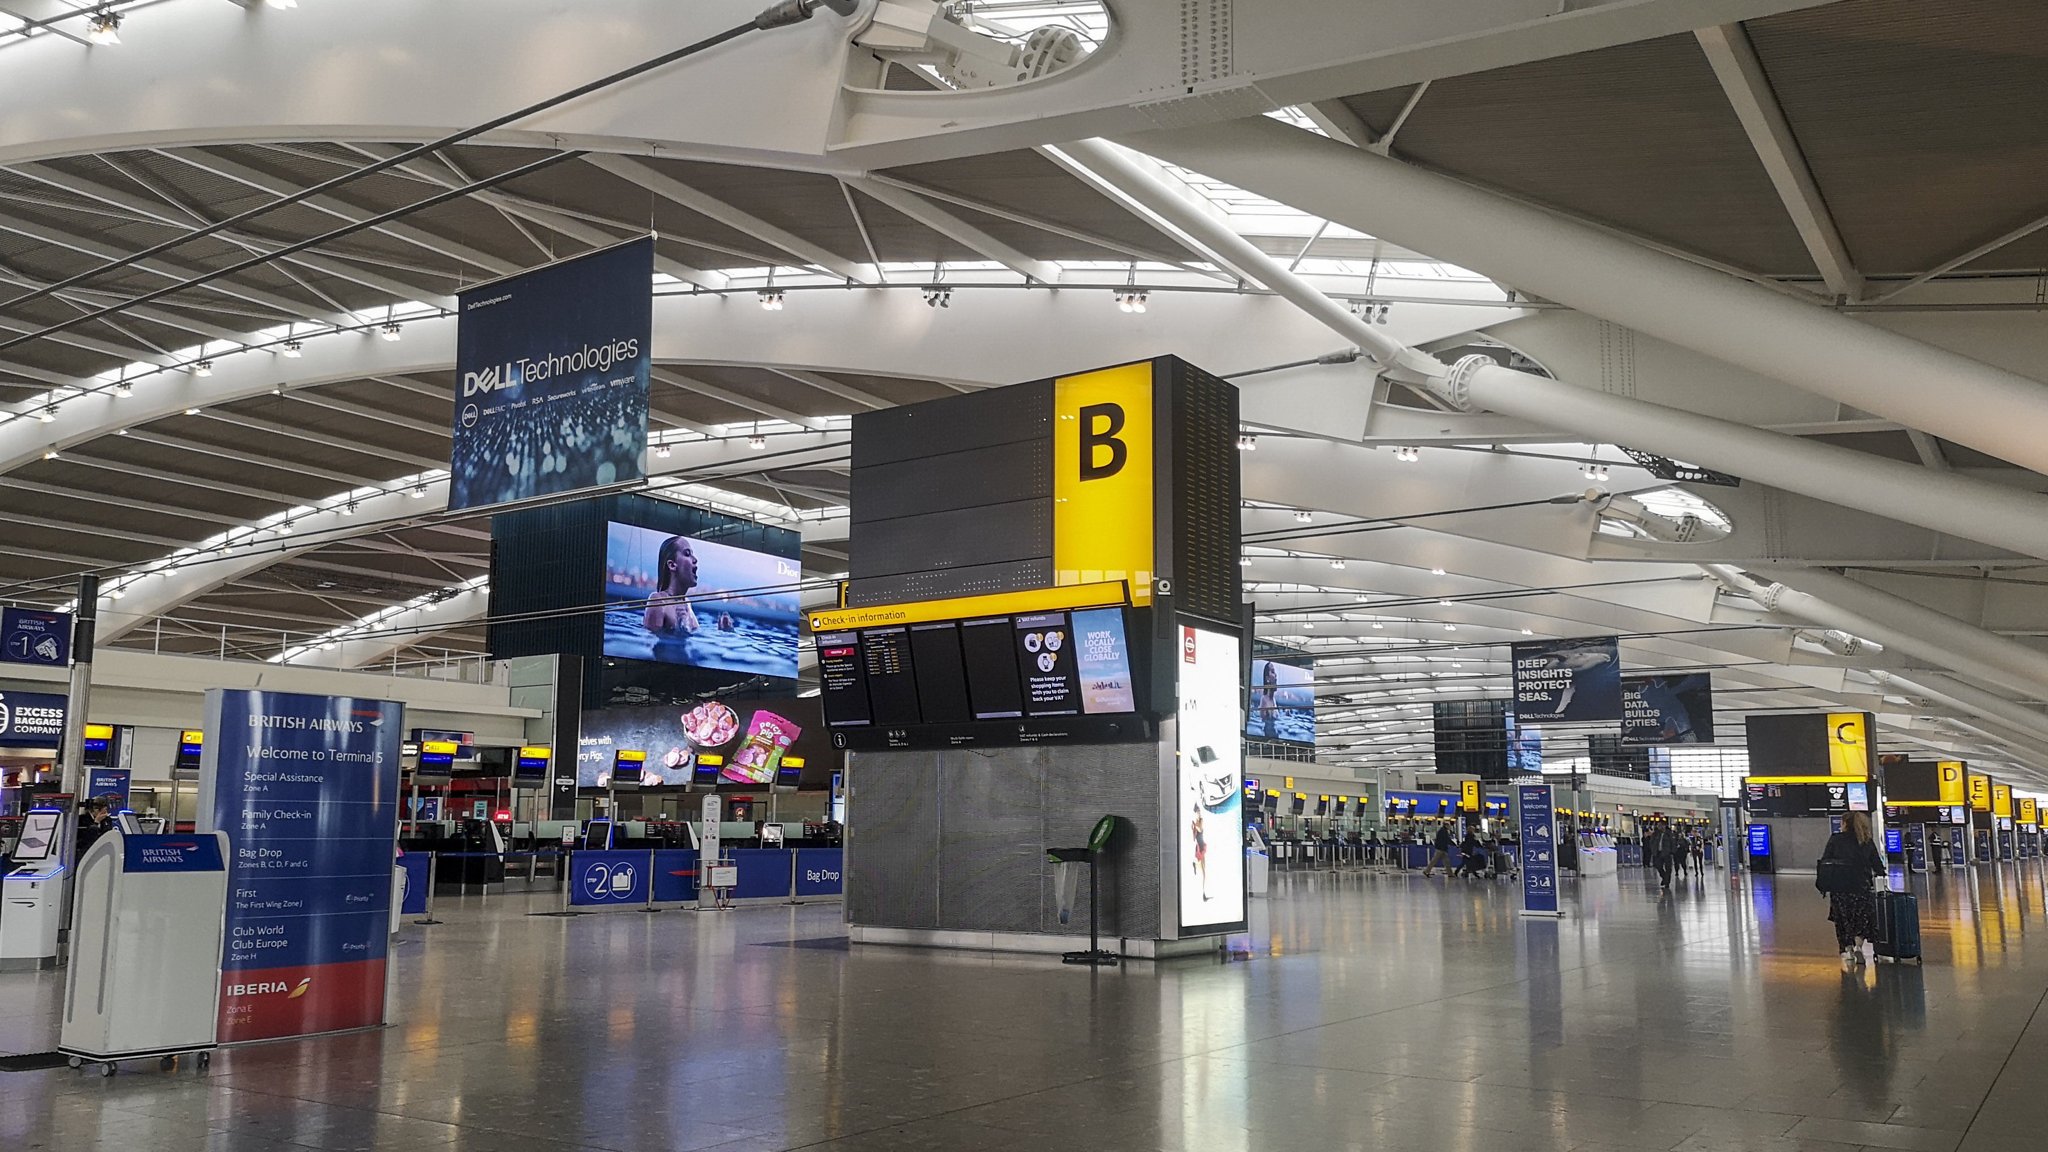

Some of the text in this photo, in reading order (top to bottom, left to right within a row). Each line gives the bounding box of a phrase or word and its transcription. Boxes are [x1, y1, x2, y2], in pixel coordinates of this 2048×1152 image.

[464, 338, 638, 398] DELL Technologies
[532, 396, 544, 404] RSA
[1080, 403, 1127, 482] B
[777, 561, 799, 578] Dior
[822, 611, 906, 626] Check-in information
[1088, 631, 1110, 639] WORK
[21, 636, 28, 655] 1
[1085, 638, 1115, 647] LOCALLY
[1090, 646, 1112, 654] CLOSE
[1084, 652, 1120, 661] GLOBALLY
[1517, 659, 1547, 668] DEEP
[1518, 669, 1573, 679] INSIGHTS
[1519, 680, 1572, 690] PROTECT
[1519, 692, 1552, 701] SEAS.
[16, 707, 63, 718] EXCESS
[14, 717, 62, 726] BAGGAGE
[249, 715, 364, 733] BRITISH AIRWAYS
[1626, 719, 1660, 727] CITIES.
[14, 725, 62, 734] COMPANY
[760, 722, 782, 735] percy
[1837, 723, 1856, 744] C
[761, 729, 774, 739] pig
[598, 735, 611, 745] with
[246, 746, 383, 763] Welcome to Terminal 5
[590, 751, 604, 762] Pigs.
[244, 772, 324, 783] Special Assistance
[1944, 768, 1957, 781] D
[1468, 786, 1473, 795] E
[1974, 780, 1983, 792] E
[1995, 790, 2003, 800] F
[2023, 801, 2032, 809] G
[242, 810, 311, 820] Family Check-in
[1530, 826, 1533, 836] 1
[239, 848, 282, 859] Bag Drop
[1530, 850, 1536, 861] 2
[594, 867, 608, 893] 2
[807, 870, 839, 882] Bag Drop
[1531, 876, 1538, 887] 3
[236, 889, 256, 897] First
[266, 901, 282, 909] Wing
[233, 925, 284, 937] Club World
[232, 938, 288, 950] Club Europe
[227, 981, 288, 996] IBERIA
[226, 1005, 246, 1014] Zona
[226, 1017, 246, 1025] Zone
